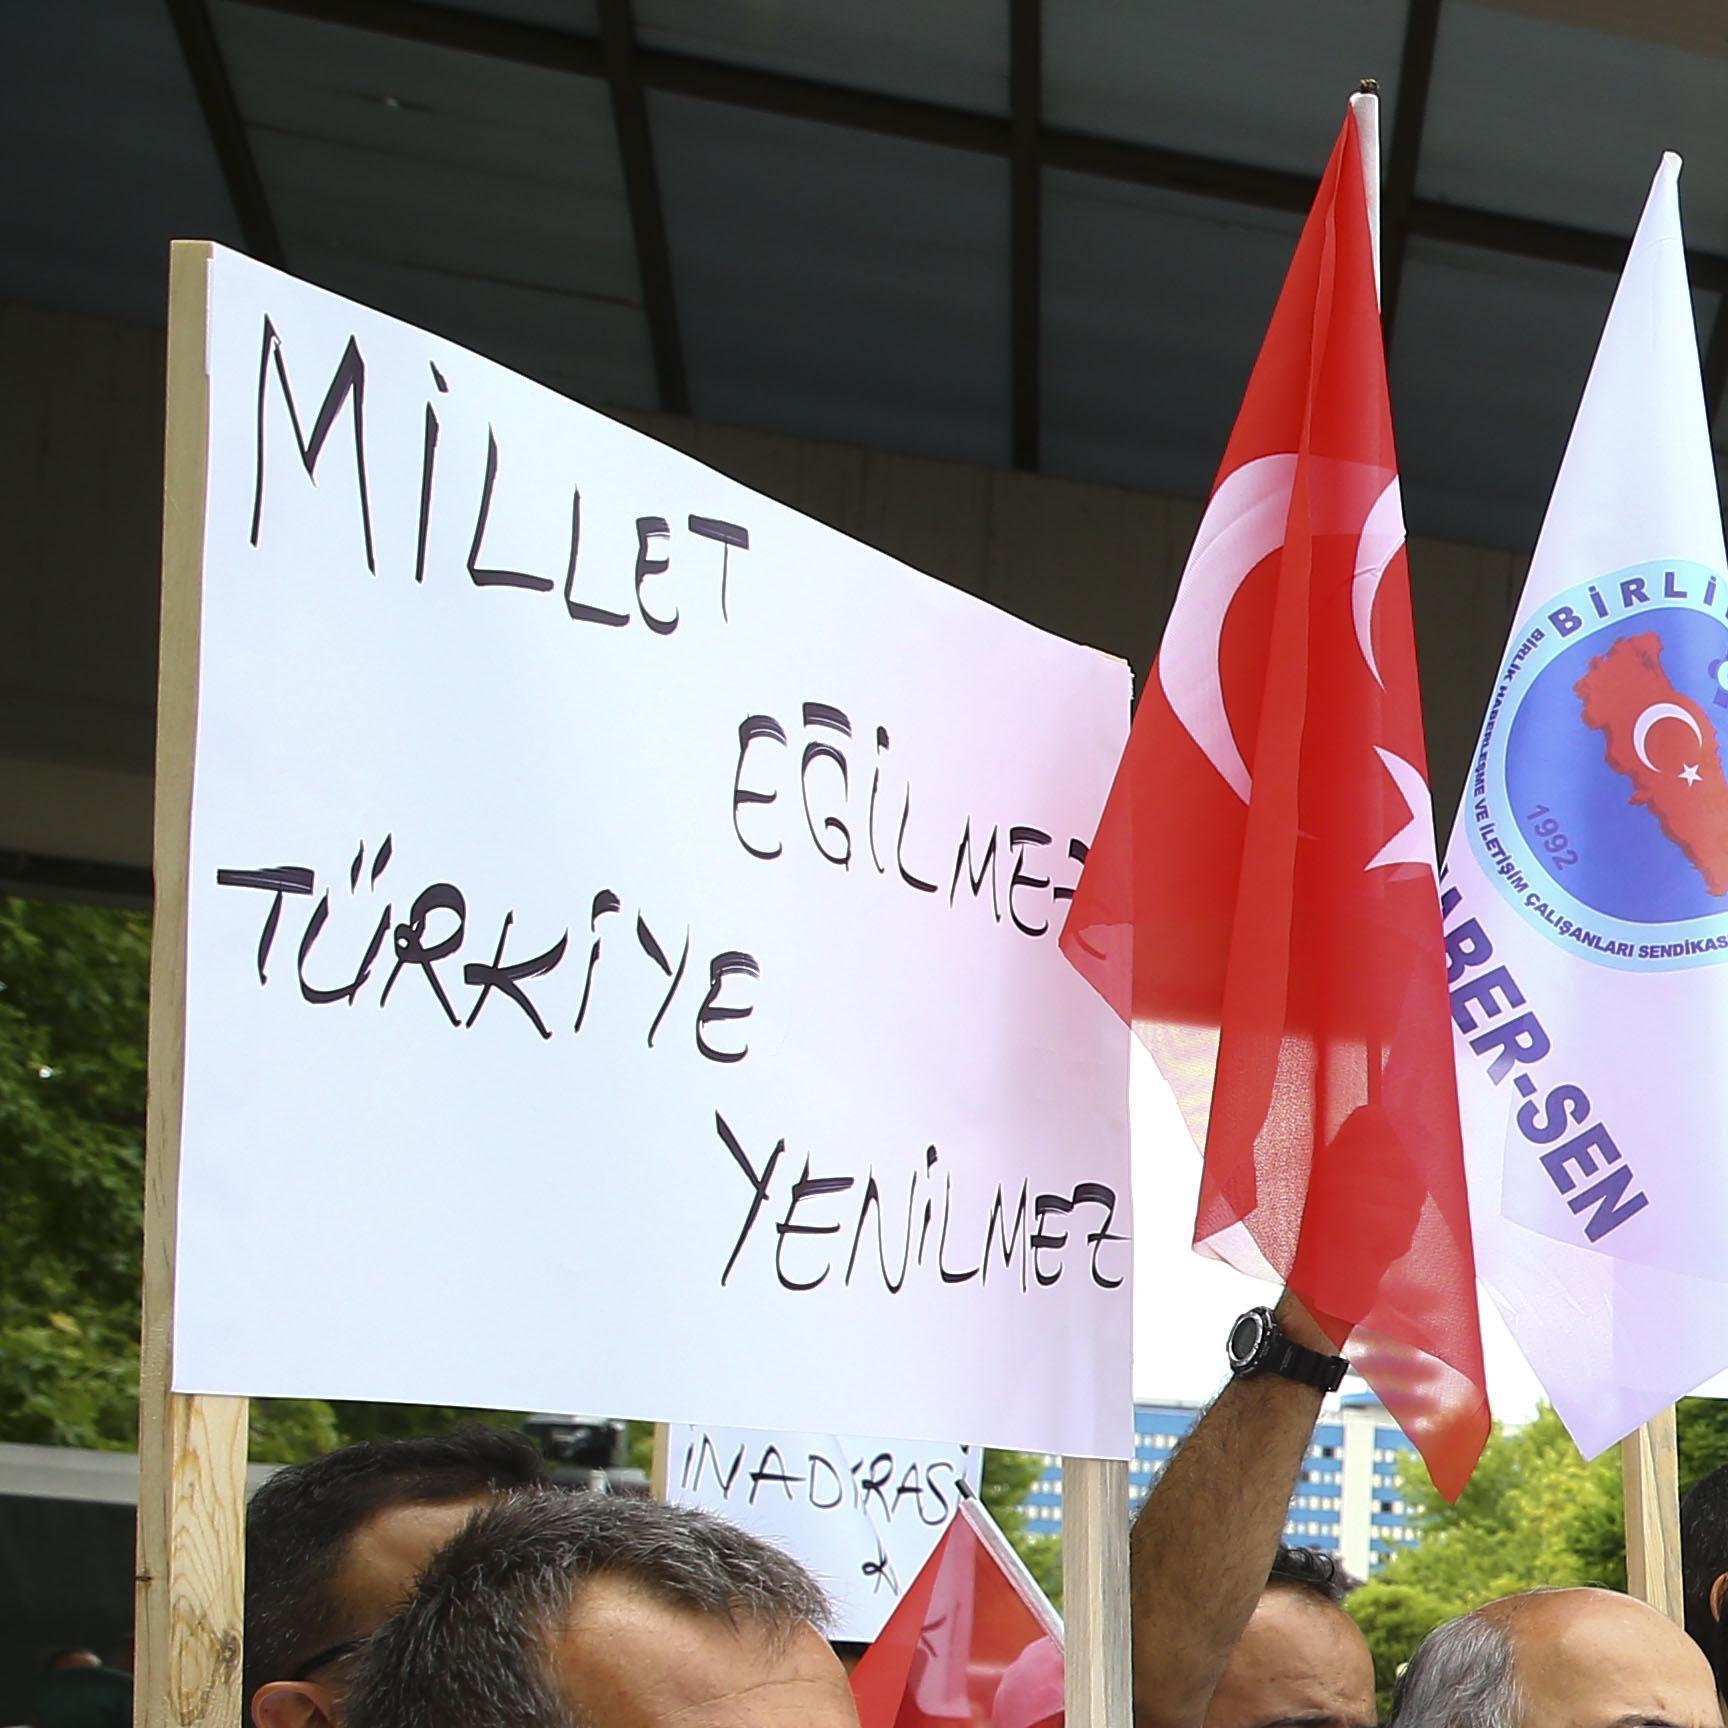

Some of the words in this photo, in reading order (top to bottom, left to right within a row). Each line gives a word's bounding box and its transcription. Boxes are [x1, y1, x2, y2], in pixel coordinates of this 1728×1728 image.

[250, 312, 750, 635] MİLLET
[1504, 628, 1546, 682] BİRLİK
[1474, 798, 1490, 821] VE
[1526, 804, 1578, 870] 1992
[1479, 822, 1529, 894] İLETİŞİM
[217, 835, 760, 1063] TÜRKİYE
[1523, 892, 1634, 958] ÇALIŞANLARI
[714, 1110, 1133, 1294] YENİLMEZ
